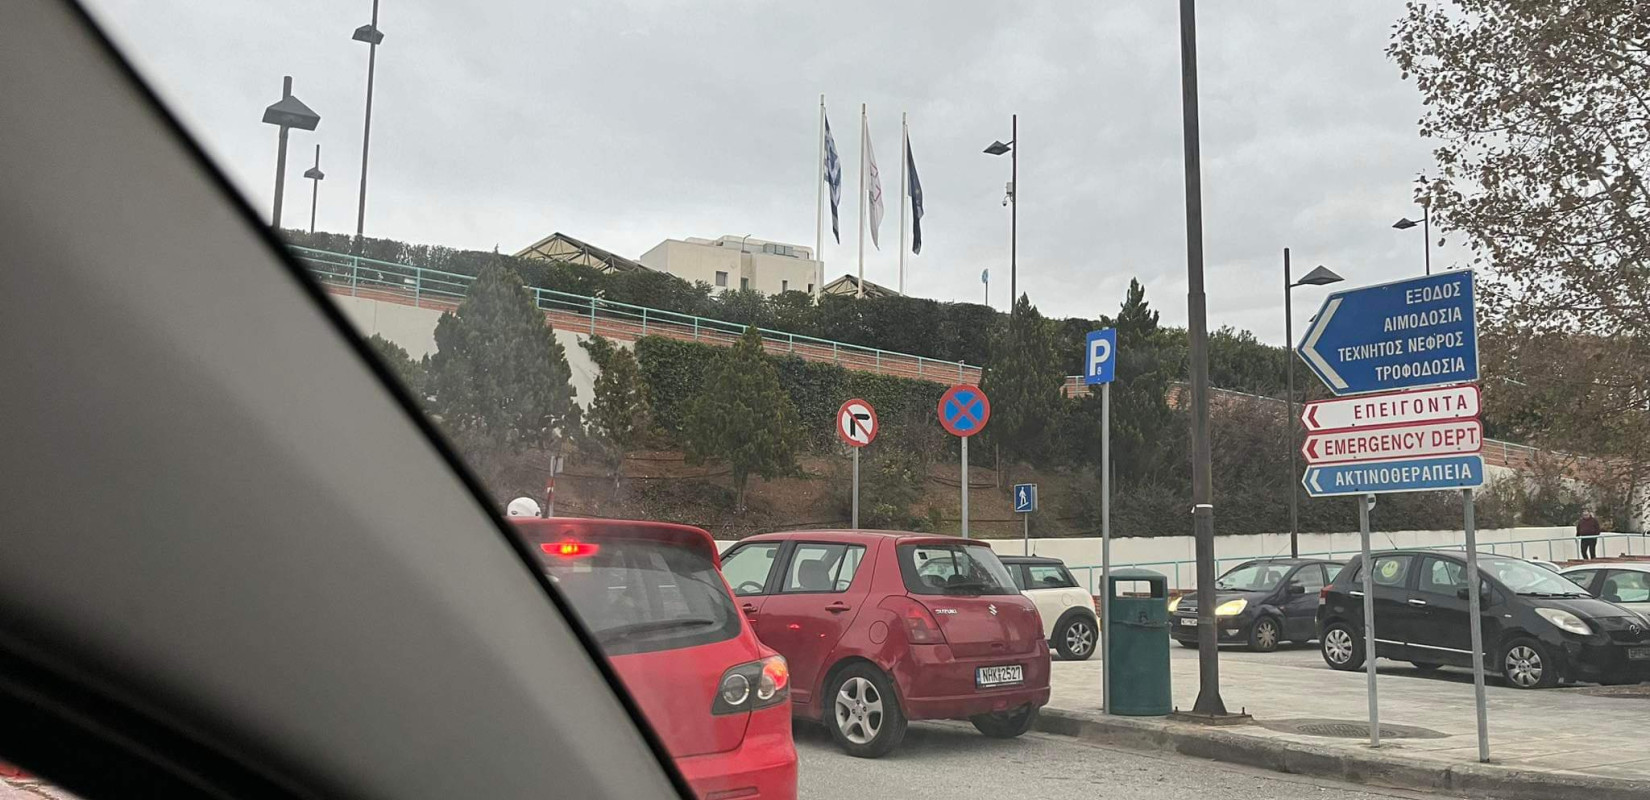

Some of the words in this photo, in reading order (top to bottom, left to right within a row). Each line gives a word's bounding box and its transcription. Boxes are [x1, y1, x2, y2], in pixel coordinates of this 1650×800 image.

[1406, 282, 1461, 304] ΕΞΟΔΟΣ
[1384, 307, 1462, 332] ΑΙΜΟΔΟΣΙΑ
[1089, 339, 1110, 376] P
[1338, 340, 1403, 362] ΤΕΧΝΗΤΟΣ
[1408, 332, 1464, 353] ΝΕΦΡΟΣ
[1375, 357, 1465, 381] ΤΡΟΦΟΔΟΣΙΑ
[1354, 394, 1467, 420] ΕΠΕΙΓΟΝΤΑ
[1325, 431, 1425, 456] EMERGENCY
[1335, 463, 1472, 487] ΑΚΤΙΝΟΘΕΡΑΠΕΙΑ
